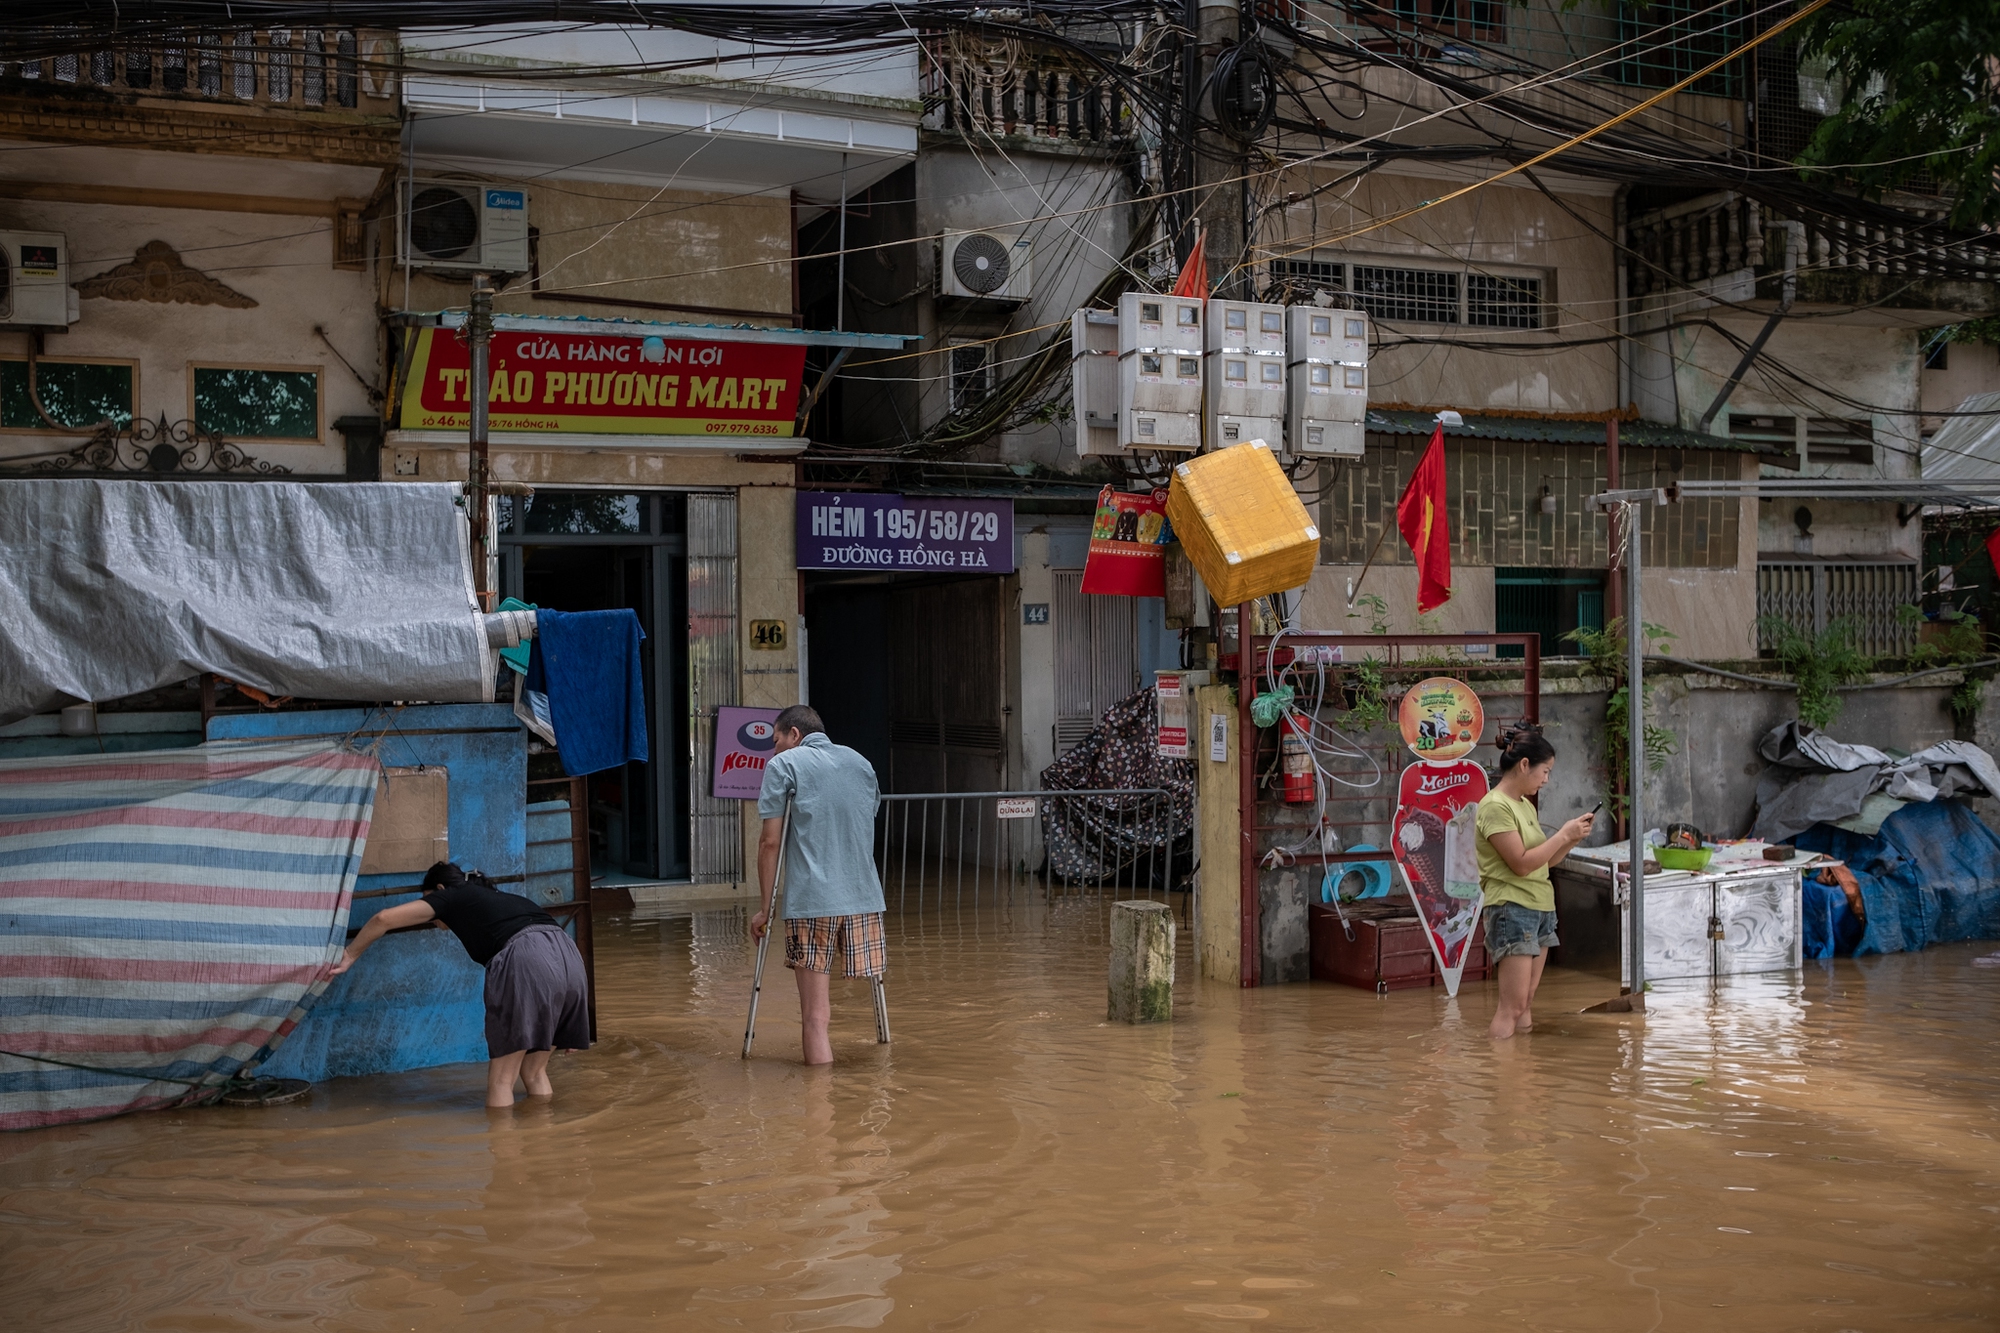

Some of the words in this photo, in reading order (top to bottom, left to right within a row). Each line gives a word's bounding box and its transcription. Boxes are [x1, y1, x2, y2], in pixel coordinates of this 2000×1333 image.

[494, 197, 520, 206] Midea
[516, 337, 561, 360] CỬA
[567, 340, 630, 363] HÀNG
[688, 346, 723, 367] LỢI
[543, 370, 680, 407] PHƯƠNG
[686, 375, 787, 410] MART
[437, 415, 455, 427] 46
[546, 420, 560, 429] HÀ
[705, 423, 779, 435] 097.979.6336
[812, 496, 865, 537] HẺM
[873, 508, 999, 542] 195/58/29
[823, 543, 893, 565] ĐƯỜNG
[898, 542, 956, 566] HỒNG
[960, 547, 988, 567] HÀ
[754, 625, 782, 644] 46
[754, 725, 766, 735] 35
[1416, 737, 1436, 750] 20
[721, 751, 766, 776] Kem
[1420, 771, 1470, 790] Merino
